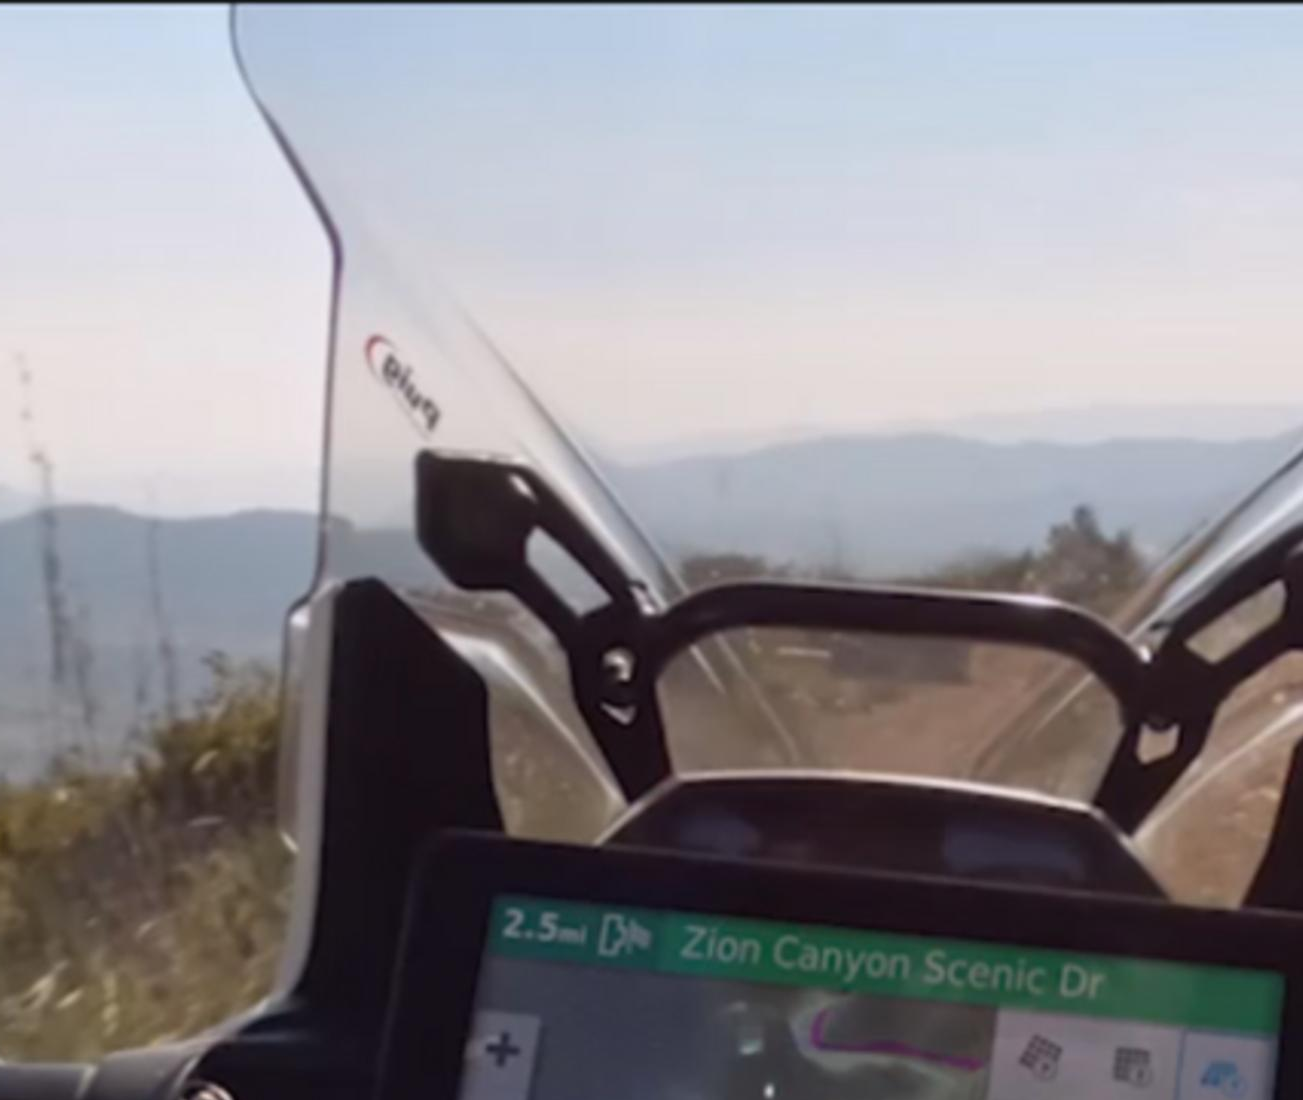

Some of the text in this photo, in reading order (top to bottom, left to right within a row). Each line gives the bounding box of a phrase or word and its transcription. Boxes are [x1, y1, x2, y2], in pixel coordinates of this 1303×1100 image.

[680, 924, 1107, 999] Zion Canyon Scenic Dr
